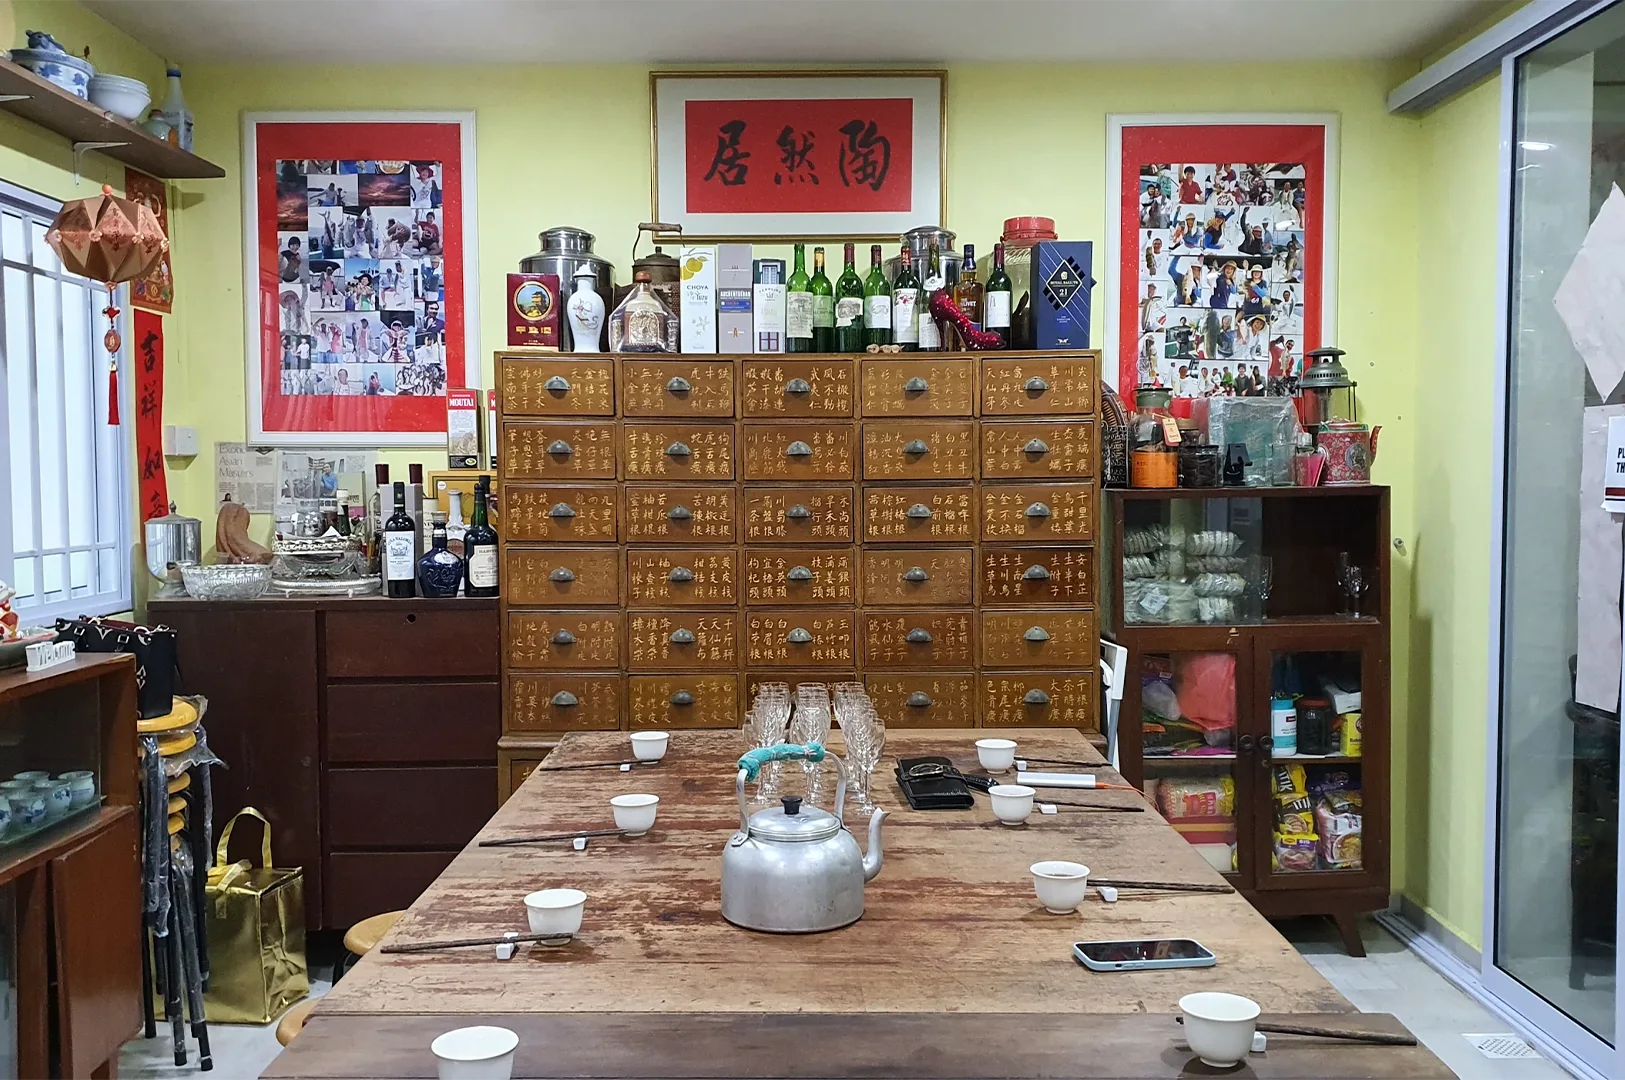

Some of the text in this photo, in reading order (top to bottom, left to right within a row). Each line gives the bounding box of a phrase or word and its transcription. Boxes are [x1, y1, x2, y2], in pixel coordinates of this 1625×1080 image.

[1059, 288, 1068, 296] 21
[449, 398, 474, 407] MOUTAI
[219, 467, 254, 477] Masters
